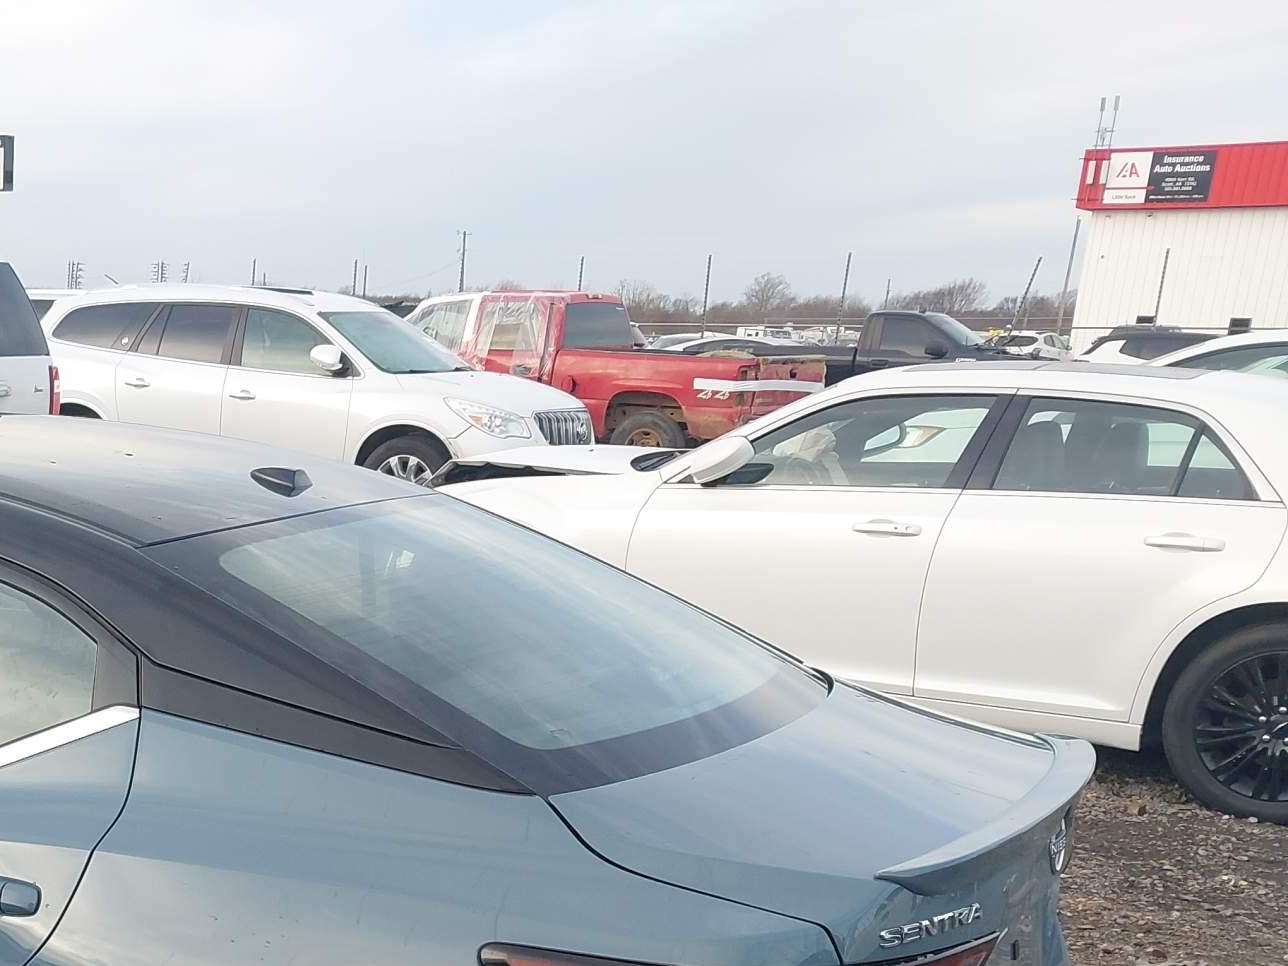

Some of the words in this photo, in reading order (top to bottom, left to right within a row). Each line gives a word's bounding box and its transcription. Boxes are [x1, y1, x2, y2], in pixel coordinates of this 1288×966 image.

[1163, 155, 1204, 164] Insurance
[1153, 164, 1173, 173] Auto
[1174, 163, 1211, 172] Auctions
[879, 903, 983, 949] SENTRA
